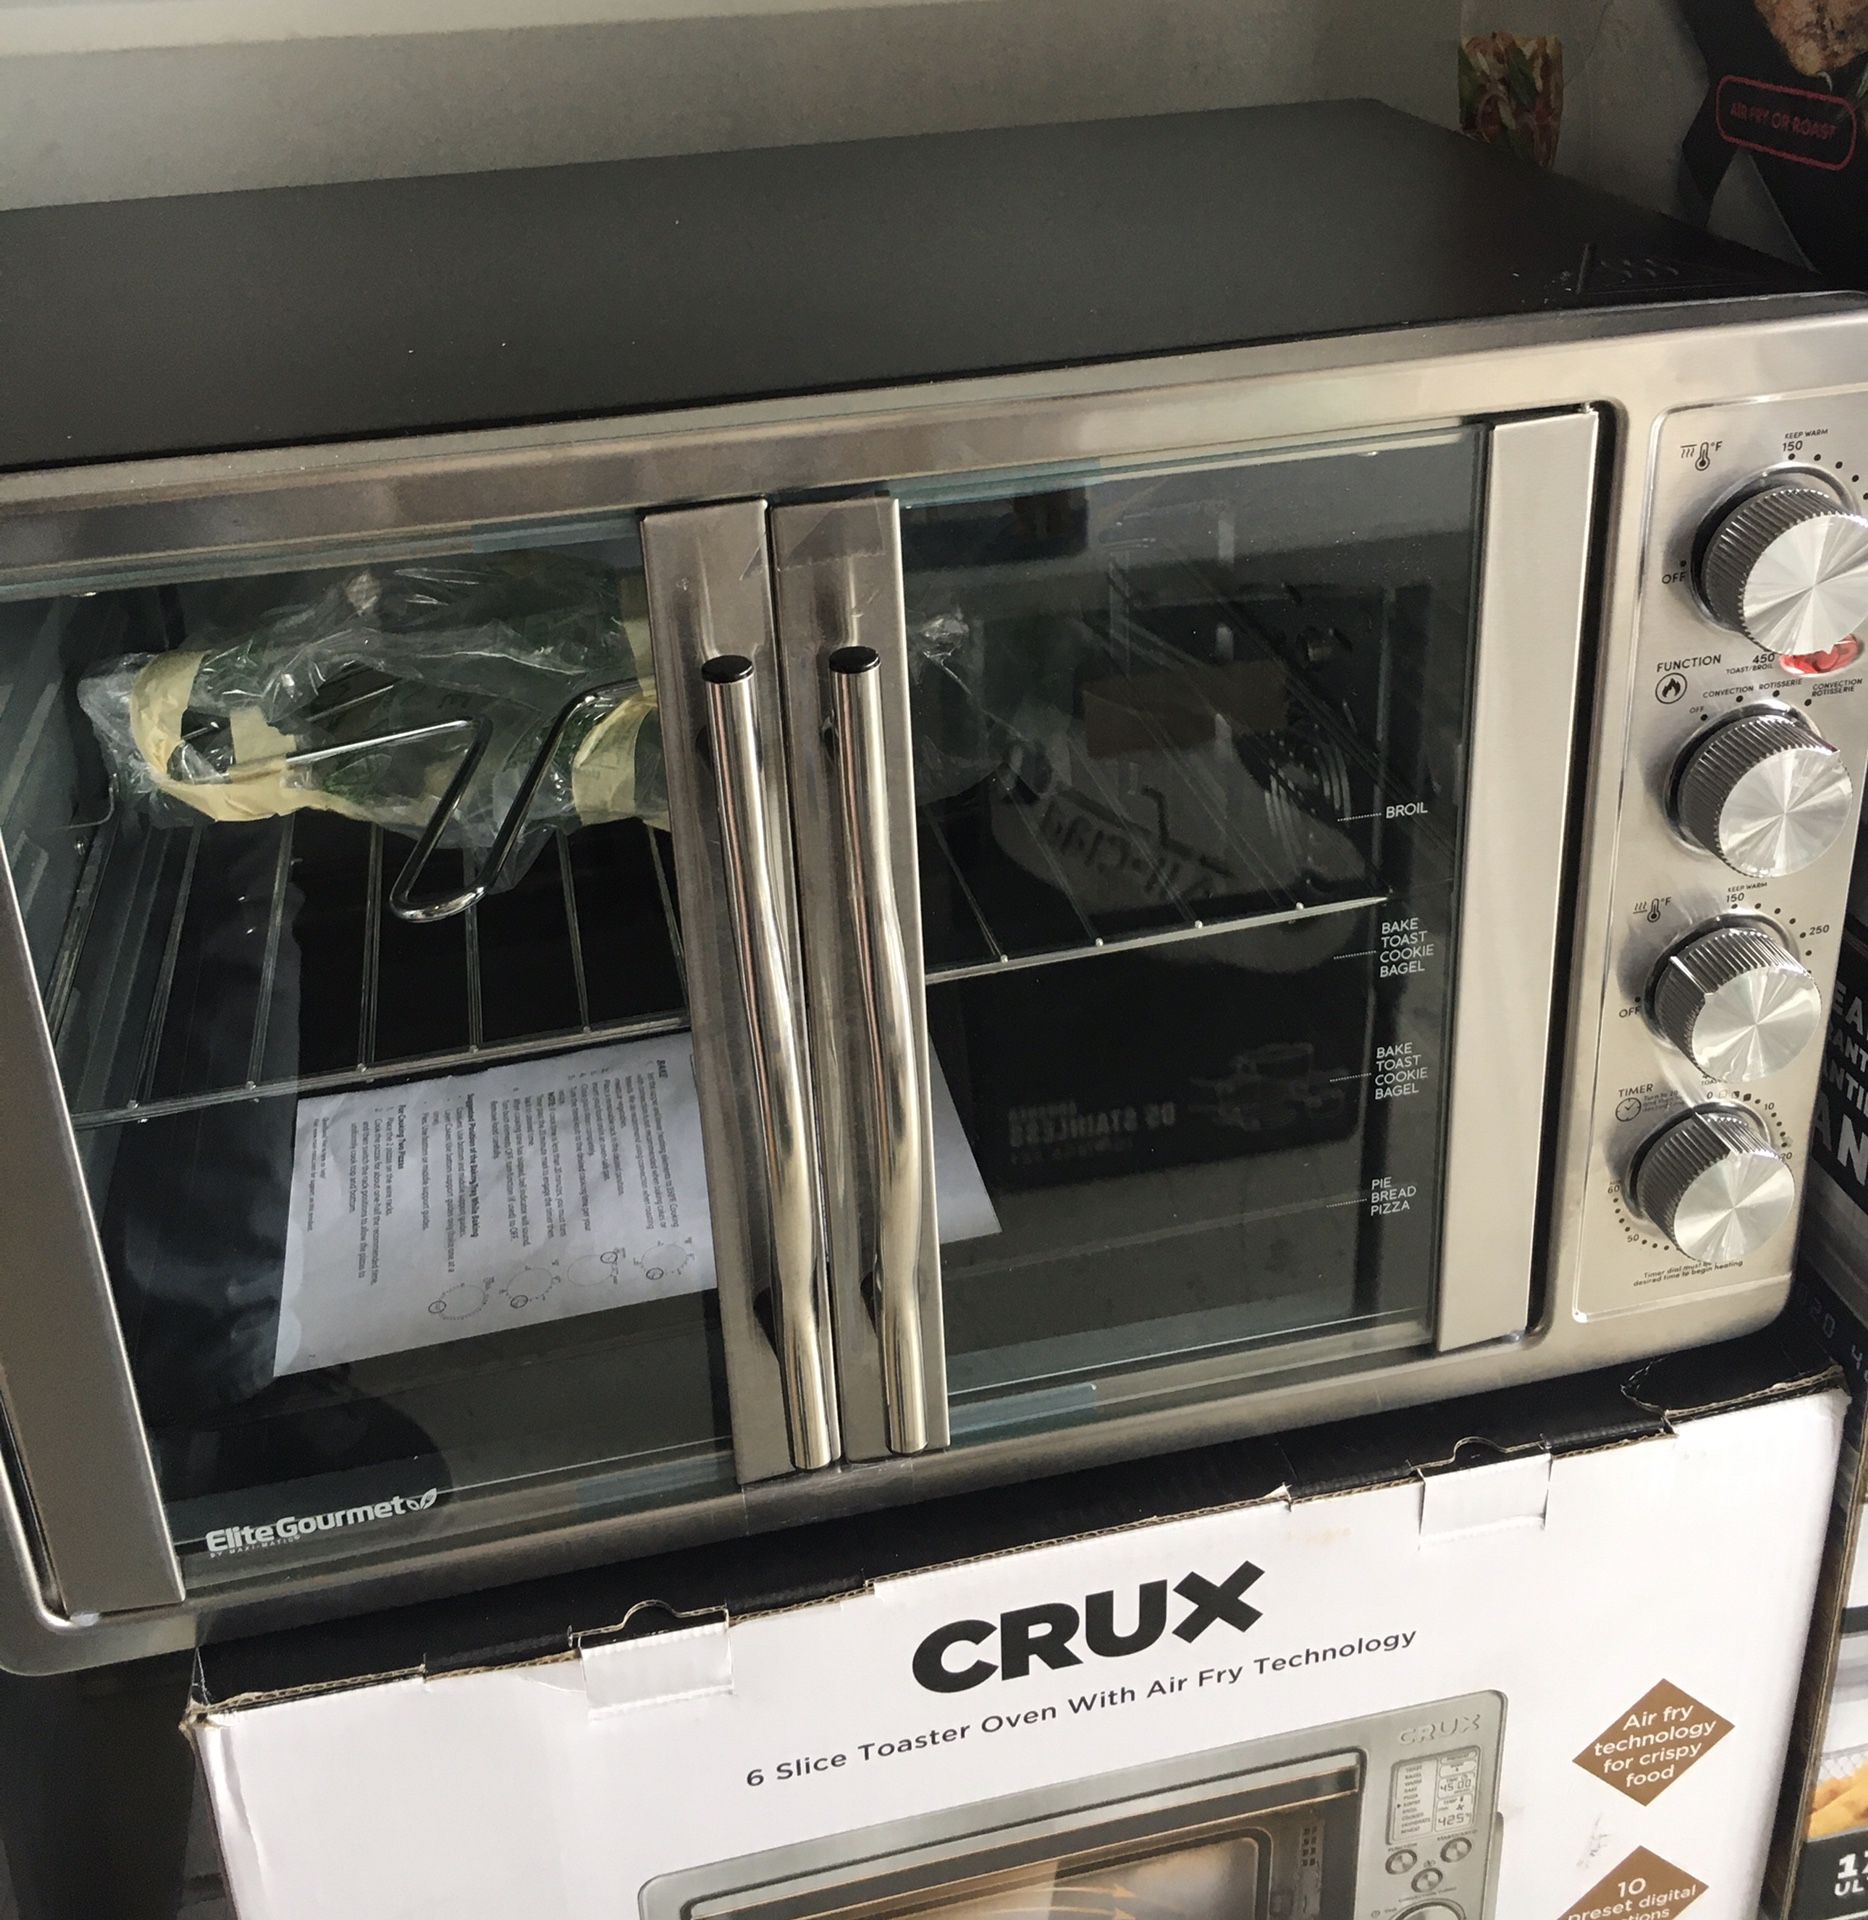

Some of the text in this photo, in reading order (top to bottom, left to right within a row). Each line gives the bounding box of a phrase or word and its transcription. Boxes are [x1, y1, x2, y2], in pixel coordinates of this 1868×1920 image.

[1785, 428, 1829, 439] KEEP WARM
[1783, 440, 1803, 452] 150
[1661, 571, 1687, 585] OFF
[1656, 654, 1722, 673] FUNCTION
[1752, 654, 1776, 664] 450
[1703, 686, 1754, 699] CONVECTION
[1759, 679, 1803, 690] ROTISSERIE
[1811, 687, 1855, 697] ROTISSERIE
[1812, 678, 1863, 691] CONVECTION
[1689, 706, 1704, 714] OFF
[1386, 802, 1428, 819] BROIL
[1727, 882, 1768, 893] KEEP WARM
[1726, 893, 1745, 903] 150
[1381, 917, 1419, 935] BAKE
[1809, 924, 1831, 936] 250
[1381, 930, 1428, 948] TOAST
[1379, 944, 1435, 963] COOKIE
[1379, 961, 1425, 978] BAGEL
[1618, 1006, 1641, 1018] OFF
[1376, 1042, 1413, 1059] BAKE
[1376, 1054, 1422, 1072] TOAST
[1374, 1067, 1429, 1086] COOKIE
[1374, 1083, 1420, 1100] BAGEL
[1618, 1083, 1654, 1098] TIMER
[1764, 1102, 1775, 1111] 10
[1371, 1177, 1392, 1191] PIE
[1608, 1184, 1620, 1194] 60
[1371, 1186, 1417, 1203] BREAD
[1370, 1200, 1411, 1217] PIZZA
[1627, 1233, 1640, 1243] 50
[1633, 1276, 1662, 1287] desired
[1663, 1273, 1680, 1281] time
[1691, 1267, 1713, 1276] begin
[1714, 1260, 1744, 1270] heating
[1644, 1270, 1665, 1279] Timer
[1667, 1265, 1682, 1274] dial
[912, 1560, 1265, 1694] CRUX
[746, 1629, 1418, 1788] 6 Slice Toaster Oven With Air Fry Technology
[1623, 1704, 1694, 1731] Air fry
[1400, 1714, 1481, 1745] CRUX
[1594, 1719, 1718, 1758] technology
[1603, 1742, 1703, 1774] for crispy
[1626, 1765, 1675, 1788] food
[1438, 1813, 1464, 1826] 425
[1617, 1877, 1647, 1898] 10
[1568, 1884, 1697, 1920] preset digital
